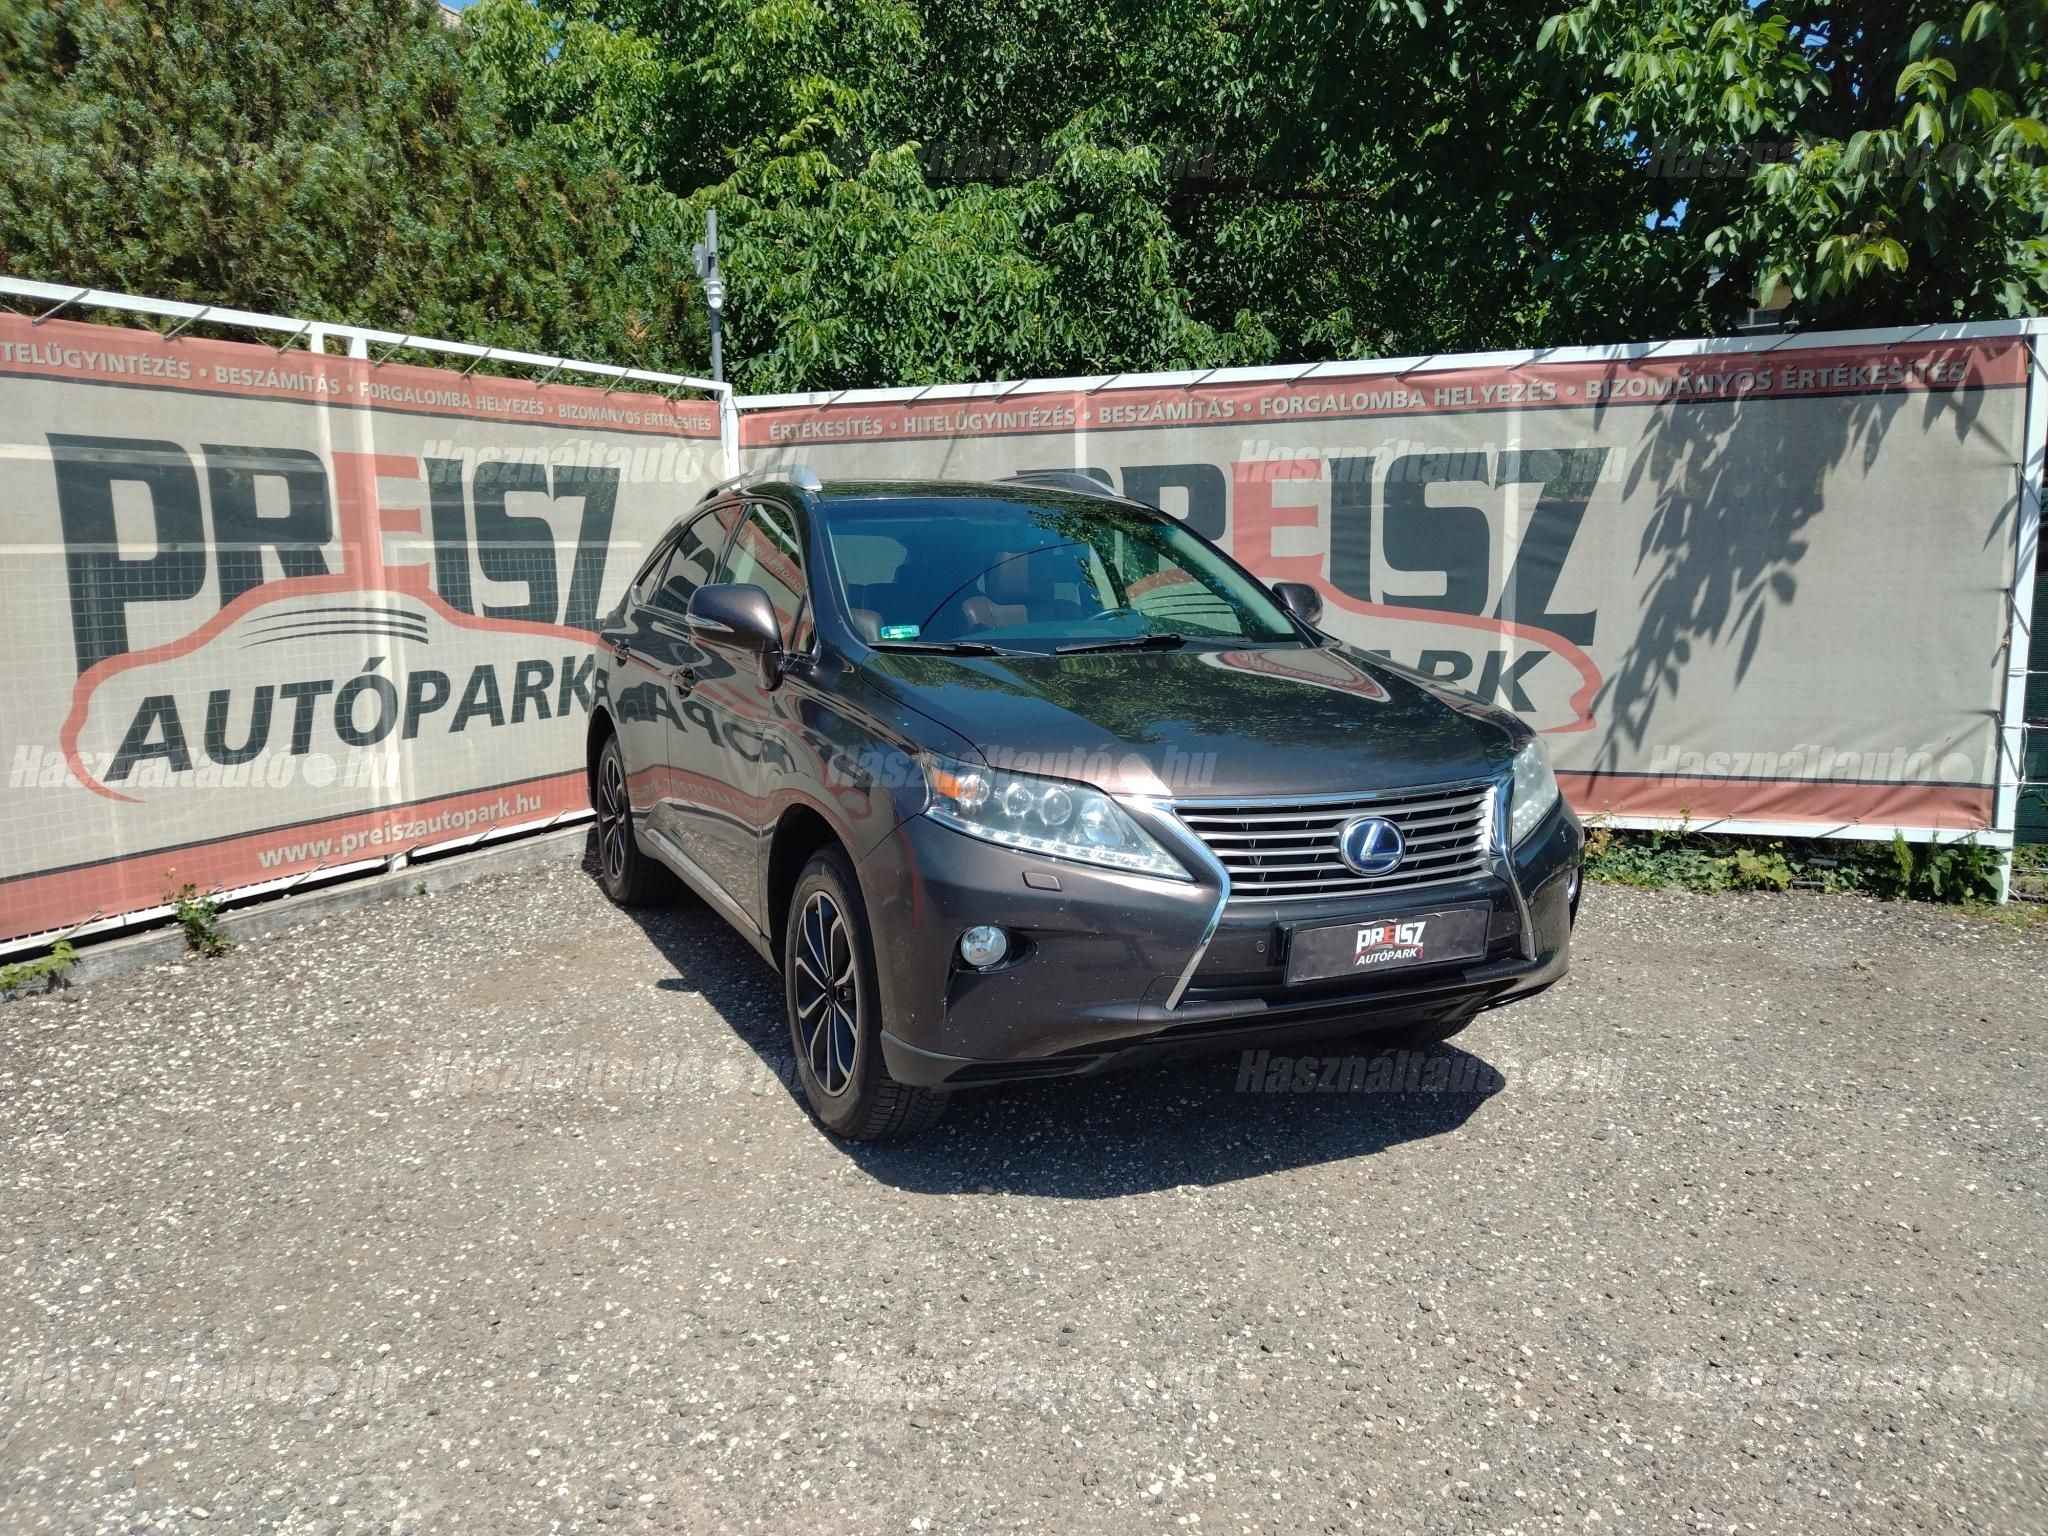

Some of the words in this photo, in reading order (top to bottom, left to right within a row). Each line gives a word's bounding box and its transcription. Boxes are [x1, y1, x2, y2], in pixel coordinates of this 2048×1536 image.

[214, 363, 341, 395] BESZÁMÍTÁS
[359, 381, 472, 410] FORGALOMBA
[476, 396, 545, 416] HELYEZÉS
[558, 403, 641, 426] BIZOMÁNYOS
[769, 415, 884, 441] ÉRTÉKESÍTÉS
[903, 407, 1077, 435] HITELÜGYINTÉZÉS
[1098, 397, 1236, 424] BESZÁMÍTÁS
[1259, 387, 1428, 416] FORGALOMBA
[1433, 378, 1558, 407] HELYEZÉS
[1585, 369, 1774, 399] BIZOMÁNYOS
[1779, 360, 1967, 389] ÉRTÉKESÍTÉS
[46, 432, 622, 680] PREISZ
[1016, 447, 1612, 647] REISZ
[103, 656, 597, 783] AUTÓPARK
[258, 795, 542, 869] www.preiszautopark.hu
[1356, 921, 1427, 954] PREISZ
[1356, 948, 1418, 966] AUTÓPARK
